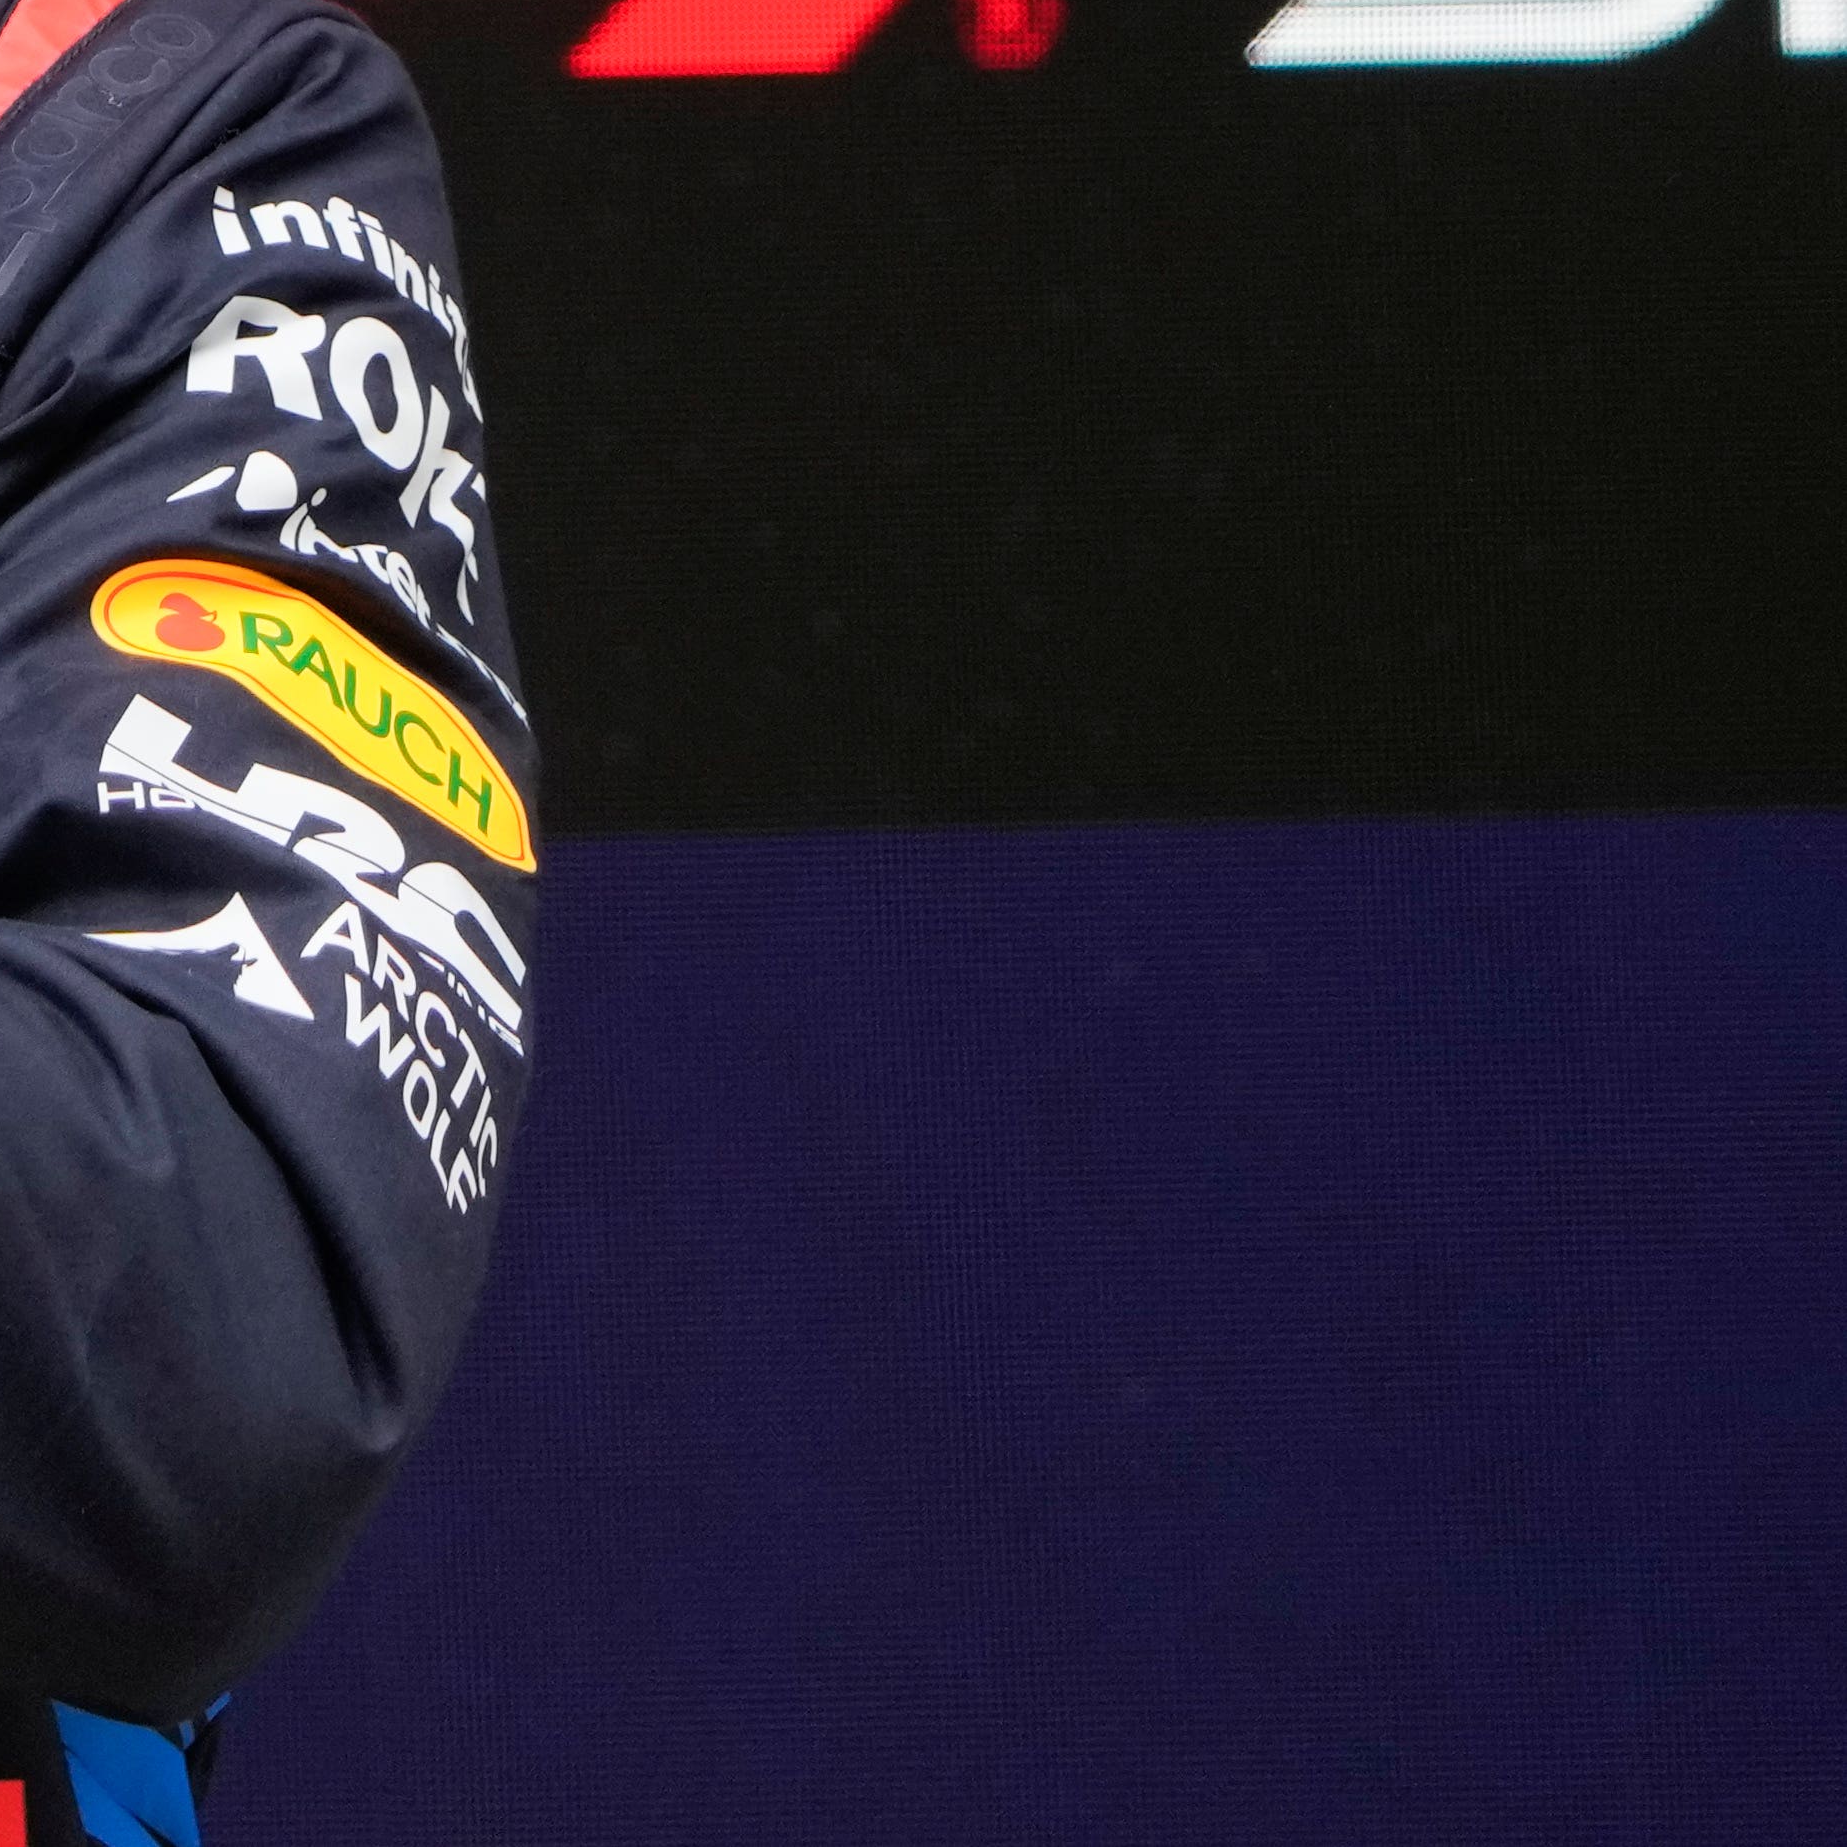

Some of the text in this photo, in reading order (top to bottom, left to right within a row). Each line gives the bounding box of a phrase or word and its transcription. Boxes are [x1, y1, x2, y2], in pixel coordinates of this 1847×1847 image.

[238, 610, 492, 836] RAUCH
[300, 900, 498, 1197] ARCTIC
[344, 973, 478, 1215] WOLF
